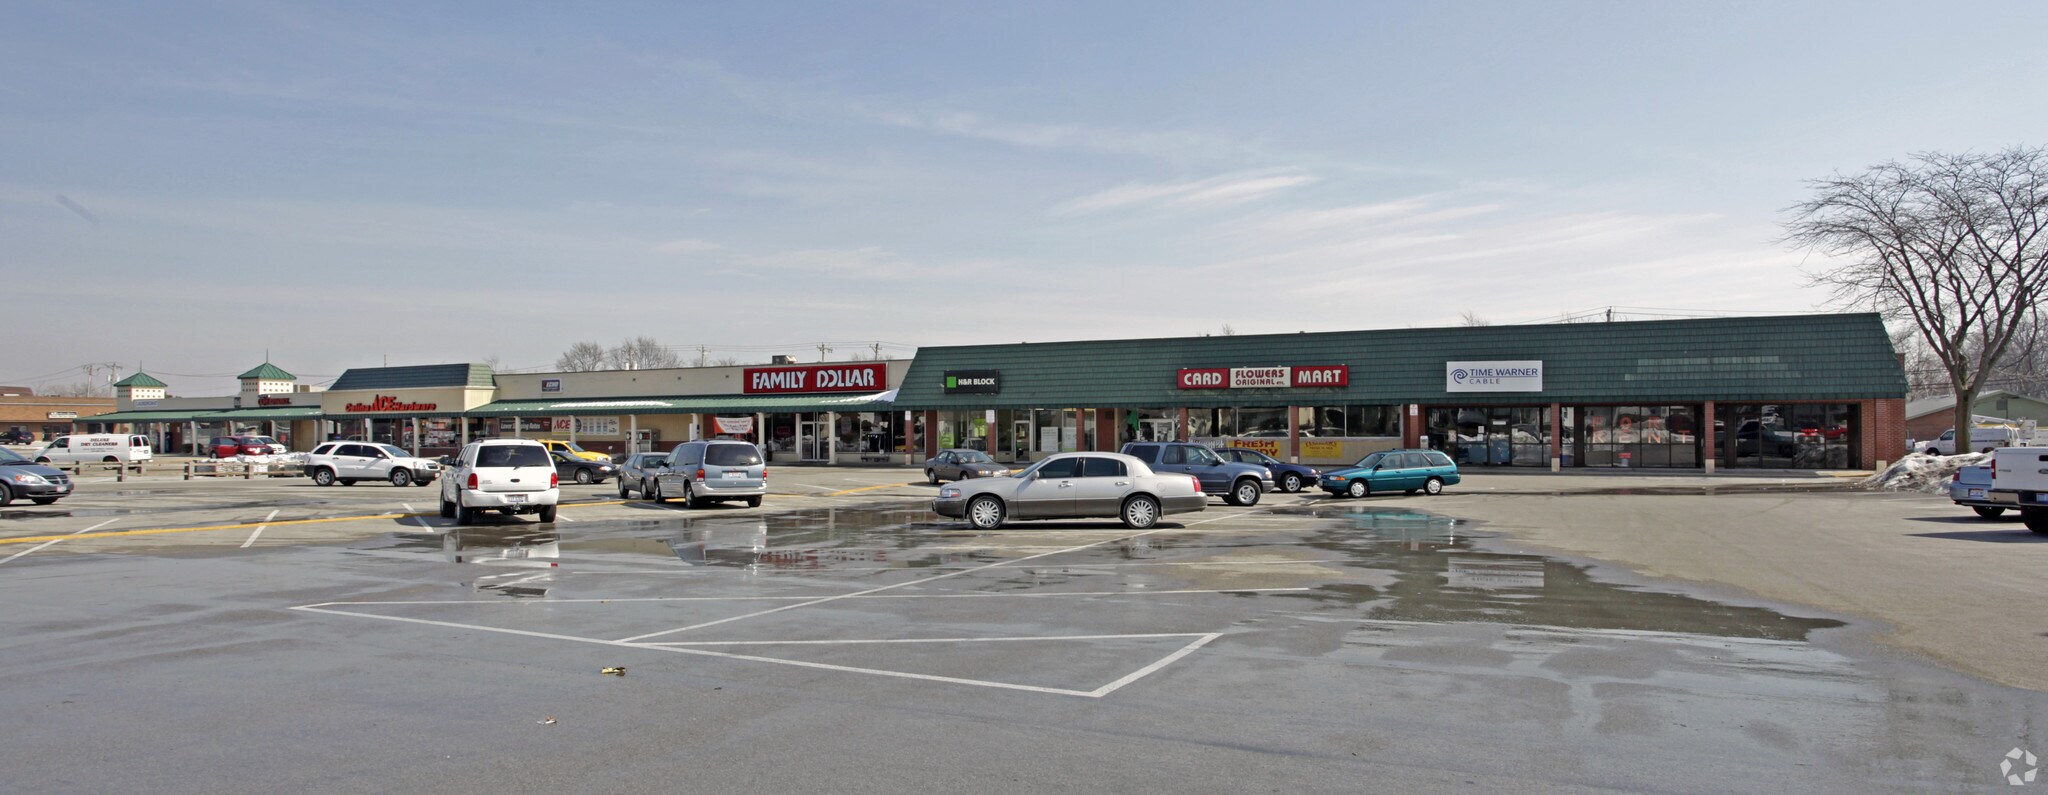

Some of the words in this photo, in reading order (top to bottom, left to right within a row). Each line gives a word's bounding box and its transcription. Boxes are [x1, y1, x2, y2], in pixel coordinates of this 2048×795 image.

[1235, 369, 1285, 379] FLOWERS
[1297, 369, 1342, 384] MART
[1469, 368, 1494, 377] TIME
[1495, 367, 1539, 376] WARNER
[752, 371, 807, 390] FAMILY
[816, 368, 875, 388] DOLLAR
[958, 378, 973, 386] H&R
[973, 377, 996, 386] BLOCK
[1183, 372, 1223, 386] CARD
[1235, 378, 1276, 386] ORIGINAL
[371, 393, 397, 411] ACE
[392, 401, 437, 411] Hardware
[554, 419, 571, 430] ACE
[1592, 430, 1691, 444] RENT
[1233, 439, 1275, 448] FRESH
